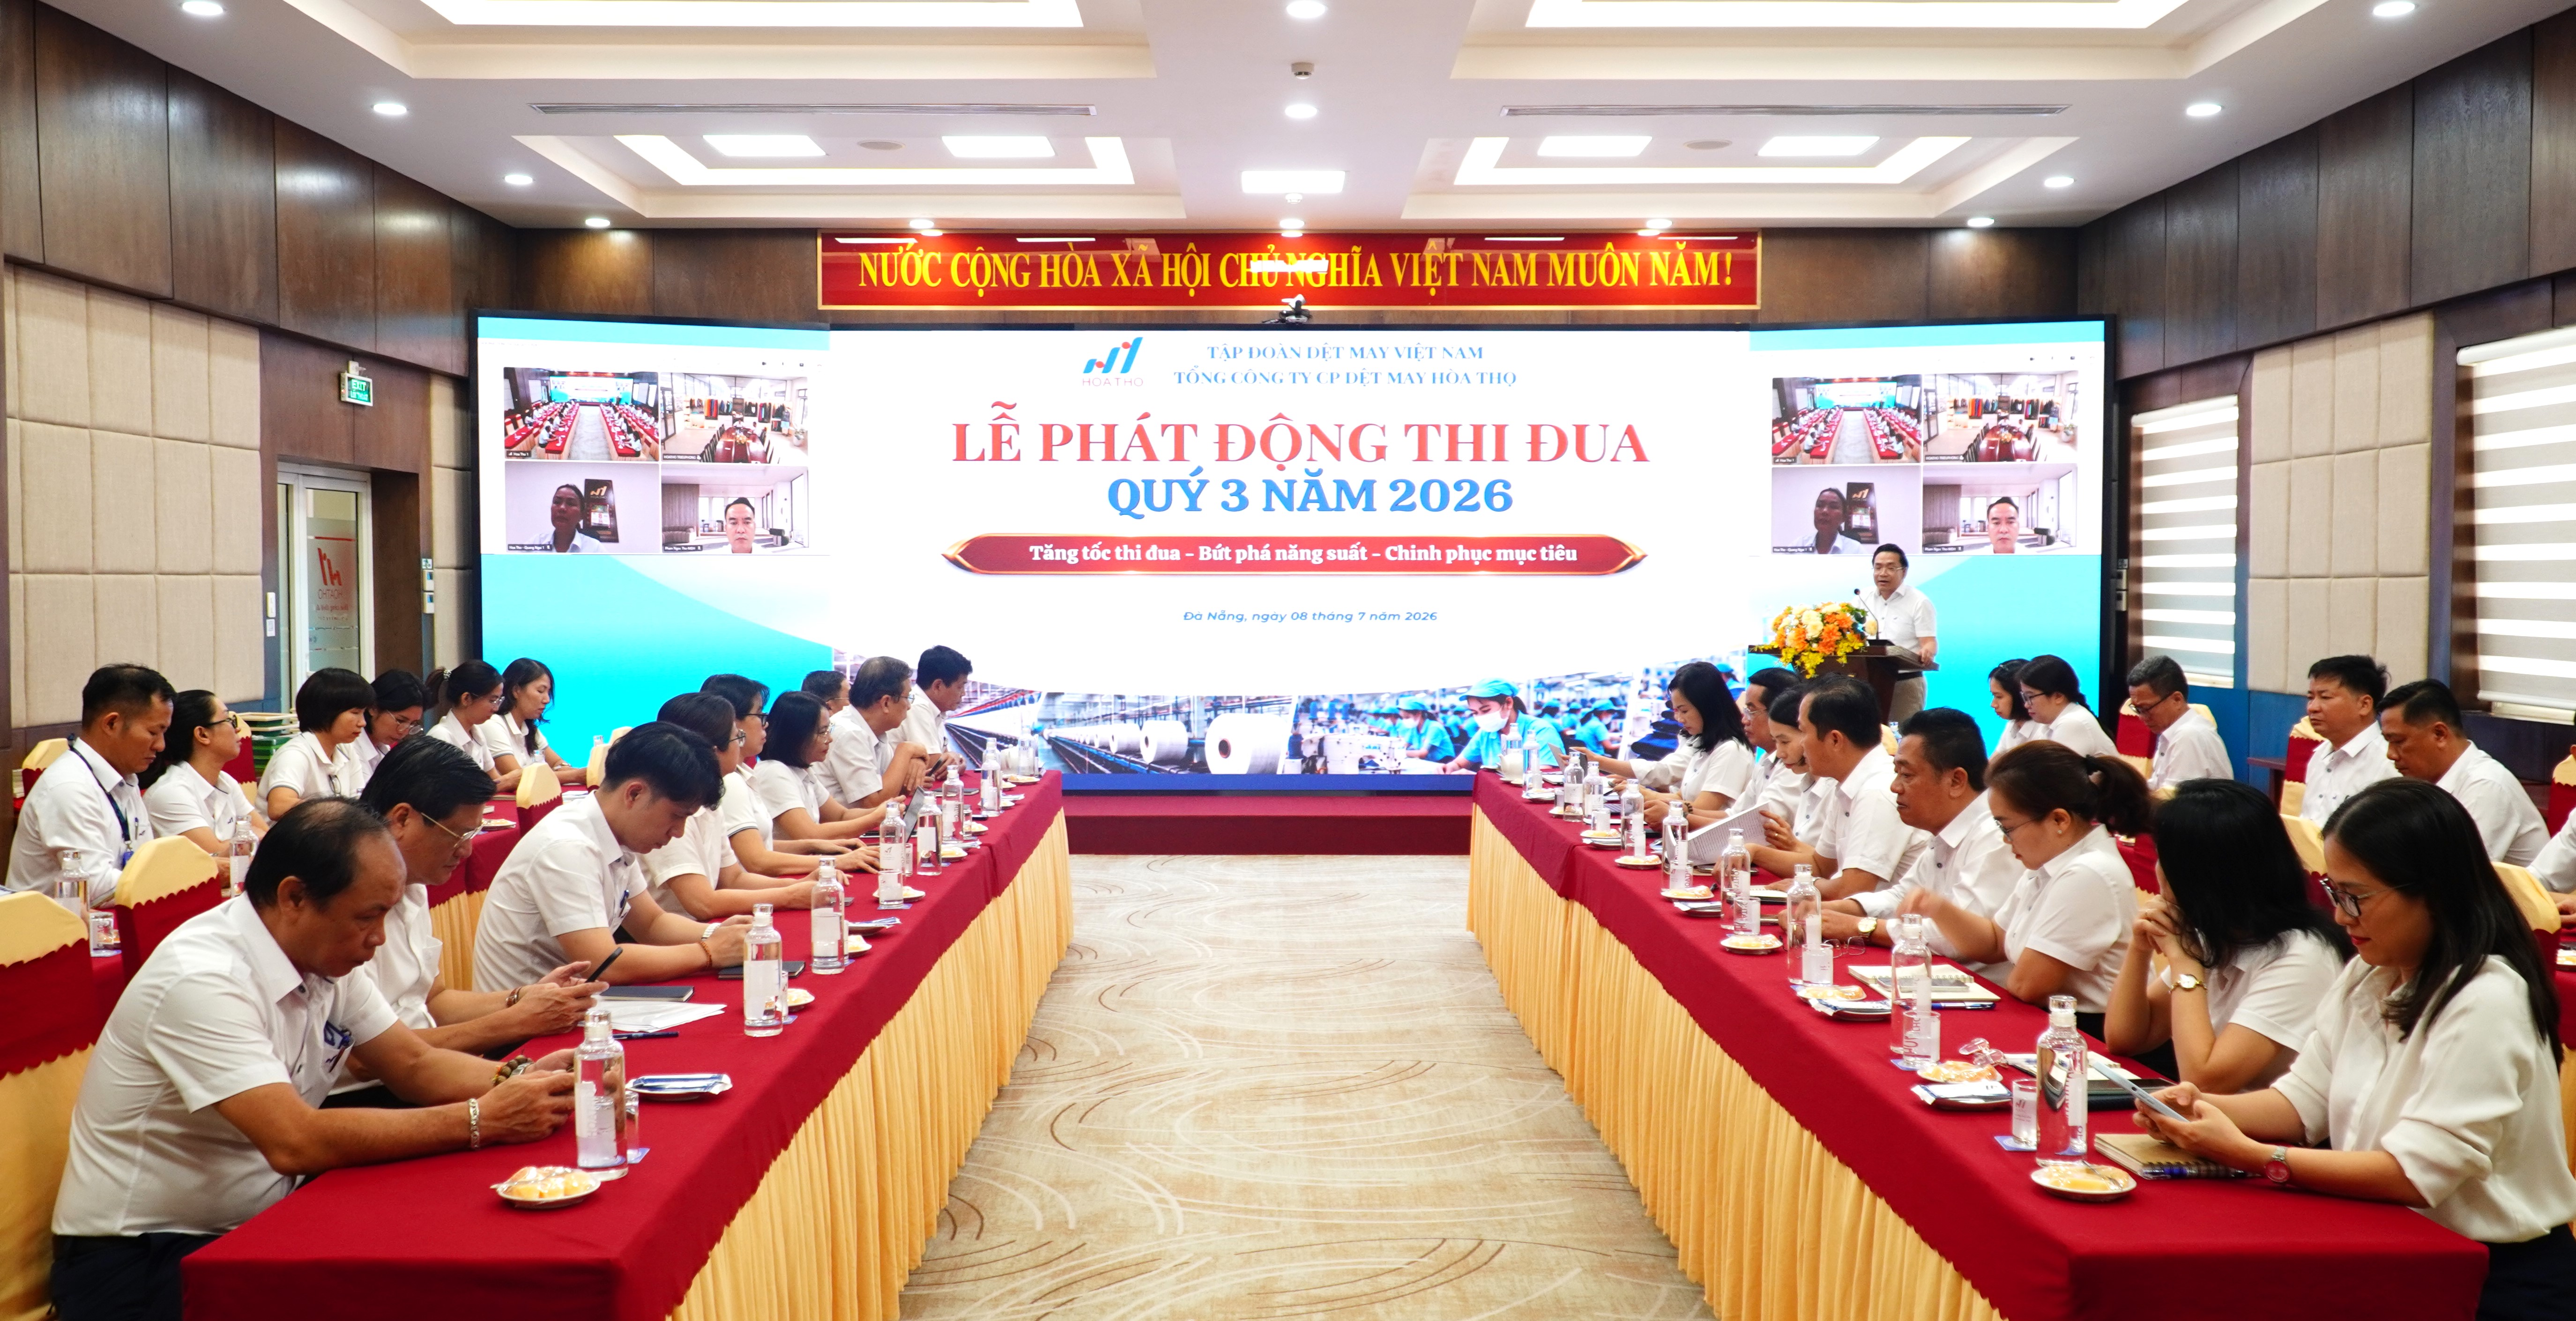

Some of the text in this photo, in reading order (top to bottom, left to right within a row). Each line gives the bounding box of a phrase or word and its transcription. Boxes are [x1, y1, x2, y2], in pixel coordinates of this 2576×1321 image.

[858, 242, 941, 287] NƯỚC
[951, 247, 1030, 297] CỘNG
[1038, 242, 1101, 287] HÒA
[1110, 245, 1153, 287] XÃ
[1161, 242, 1211, 297] HỘI
[1220, 244, 1281, 287] CHỦ
[1285, 245, 1383, 287] NGHĨA
[1390, 241, 1463, 296] VIỆT
[1472, 252, 1538, 287] NAM
[1548, 242, 1639, 287] MUÔN
[1207, 342, 1483, 362] TẬP ĐOÀN DỆT MAY VIỆT NAM
[351, 379, 366, 391] EXIT
[1173, 365, 1517, 387] TỔNG CÔNG TY CP DỆT MAY HÒA THỌ
[952, 401, 1650, 472] LỄ PHÁT ĐỘNG THI ĐUA
[1108, 466, 1513, 519] QUÝ 3 NĂM 2026
[1029, 544, 1079, 564] Tăng
[1082, 542, 1111, 561] tốc
[1115, 544, 1142, 561] thi
[1145, 544, 1181, 561] đua
[1199, 543, 1232, 561] Bứt
[1235, 543, 1271, 564] phá
[1274, 544, 1324, 564] năng
[1326, 542, 1368, 561] suất
[1385, 544, 1442, 561] Chinh
[1445, 544, 1492, 565] phục
[1495, 549, 1537, 565] mục
[1540, 544, 1578, 561] tiêu
[1184, 611, 1203, 621] Đà
[1207, 610, 1247, 623] Nẵng,
[1252, 612, 1287, 622] ngày
[1290, 612, 1308, 621] 08
[1312, 612, 1353, 622] tháng
[1370, 612, 1400, 621] năm
[1405, 612, 1437, 621] 2026
